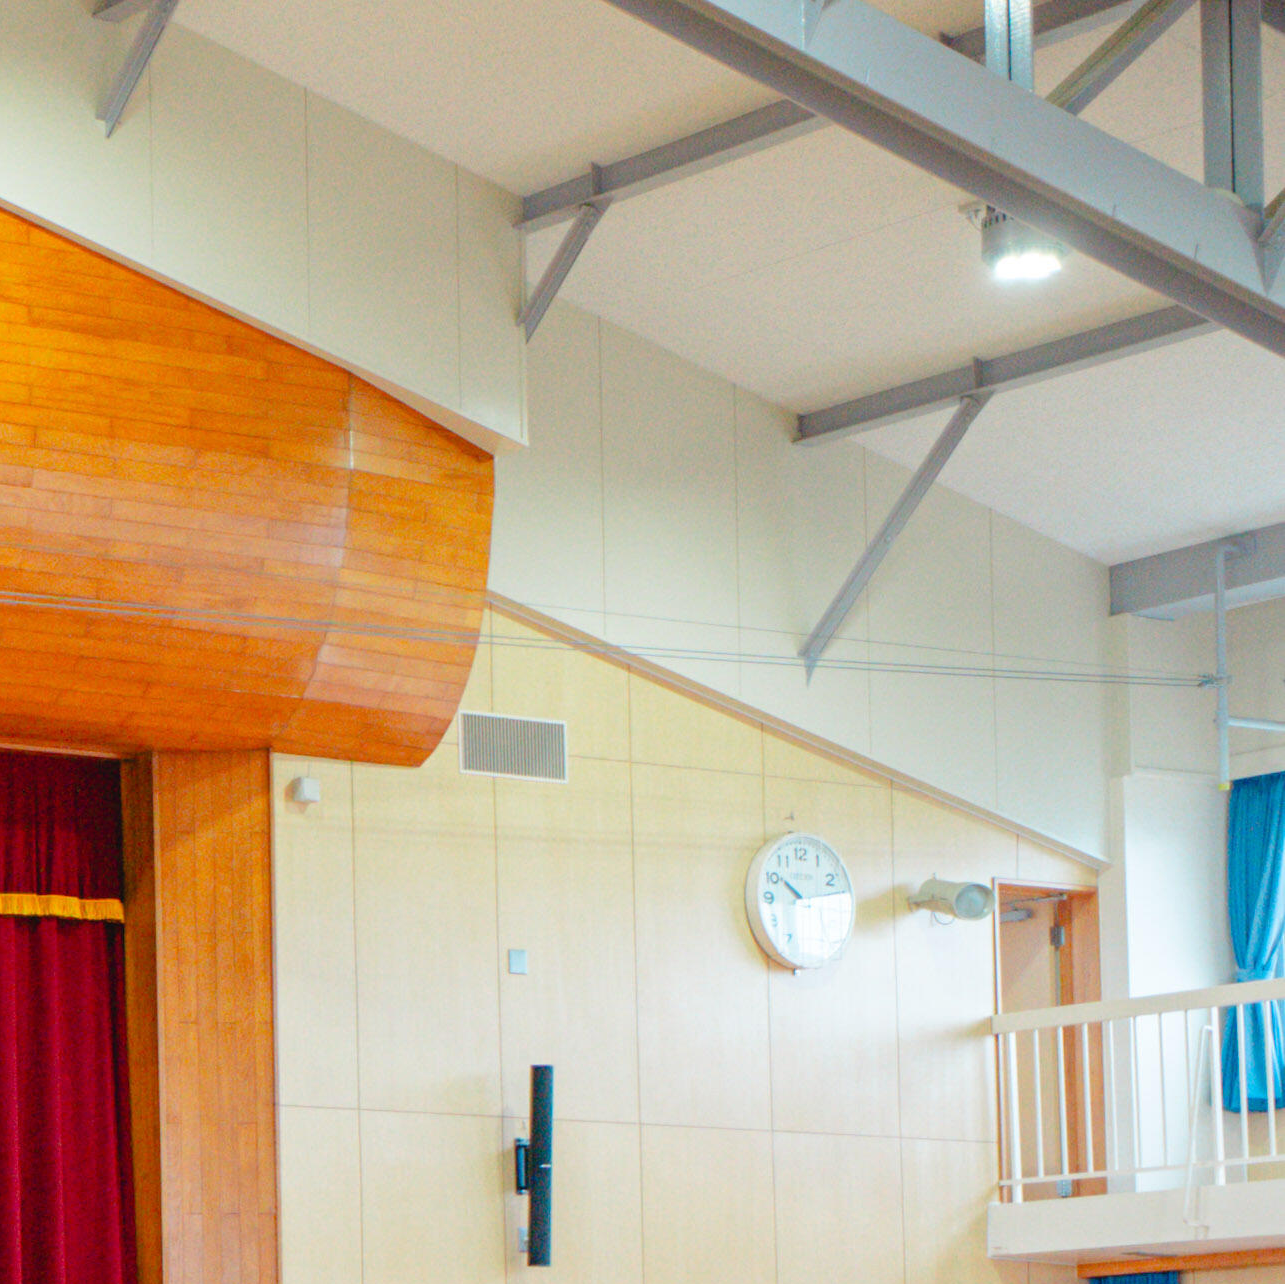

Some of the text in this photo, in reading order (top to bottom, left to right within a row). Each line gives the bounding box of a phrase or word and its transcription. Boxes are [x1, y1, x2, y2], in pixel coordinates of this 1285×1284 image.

[794, 847, 808, 862] 12
[766, 871, 780, 885] 10
[825, 873, 835, 887] 2
[763, 891, 775, 905] 9
